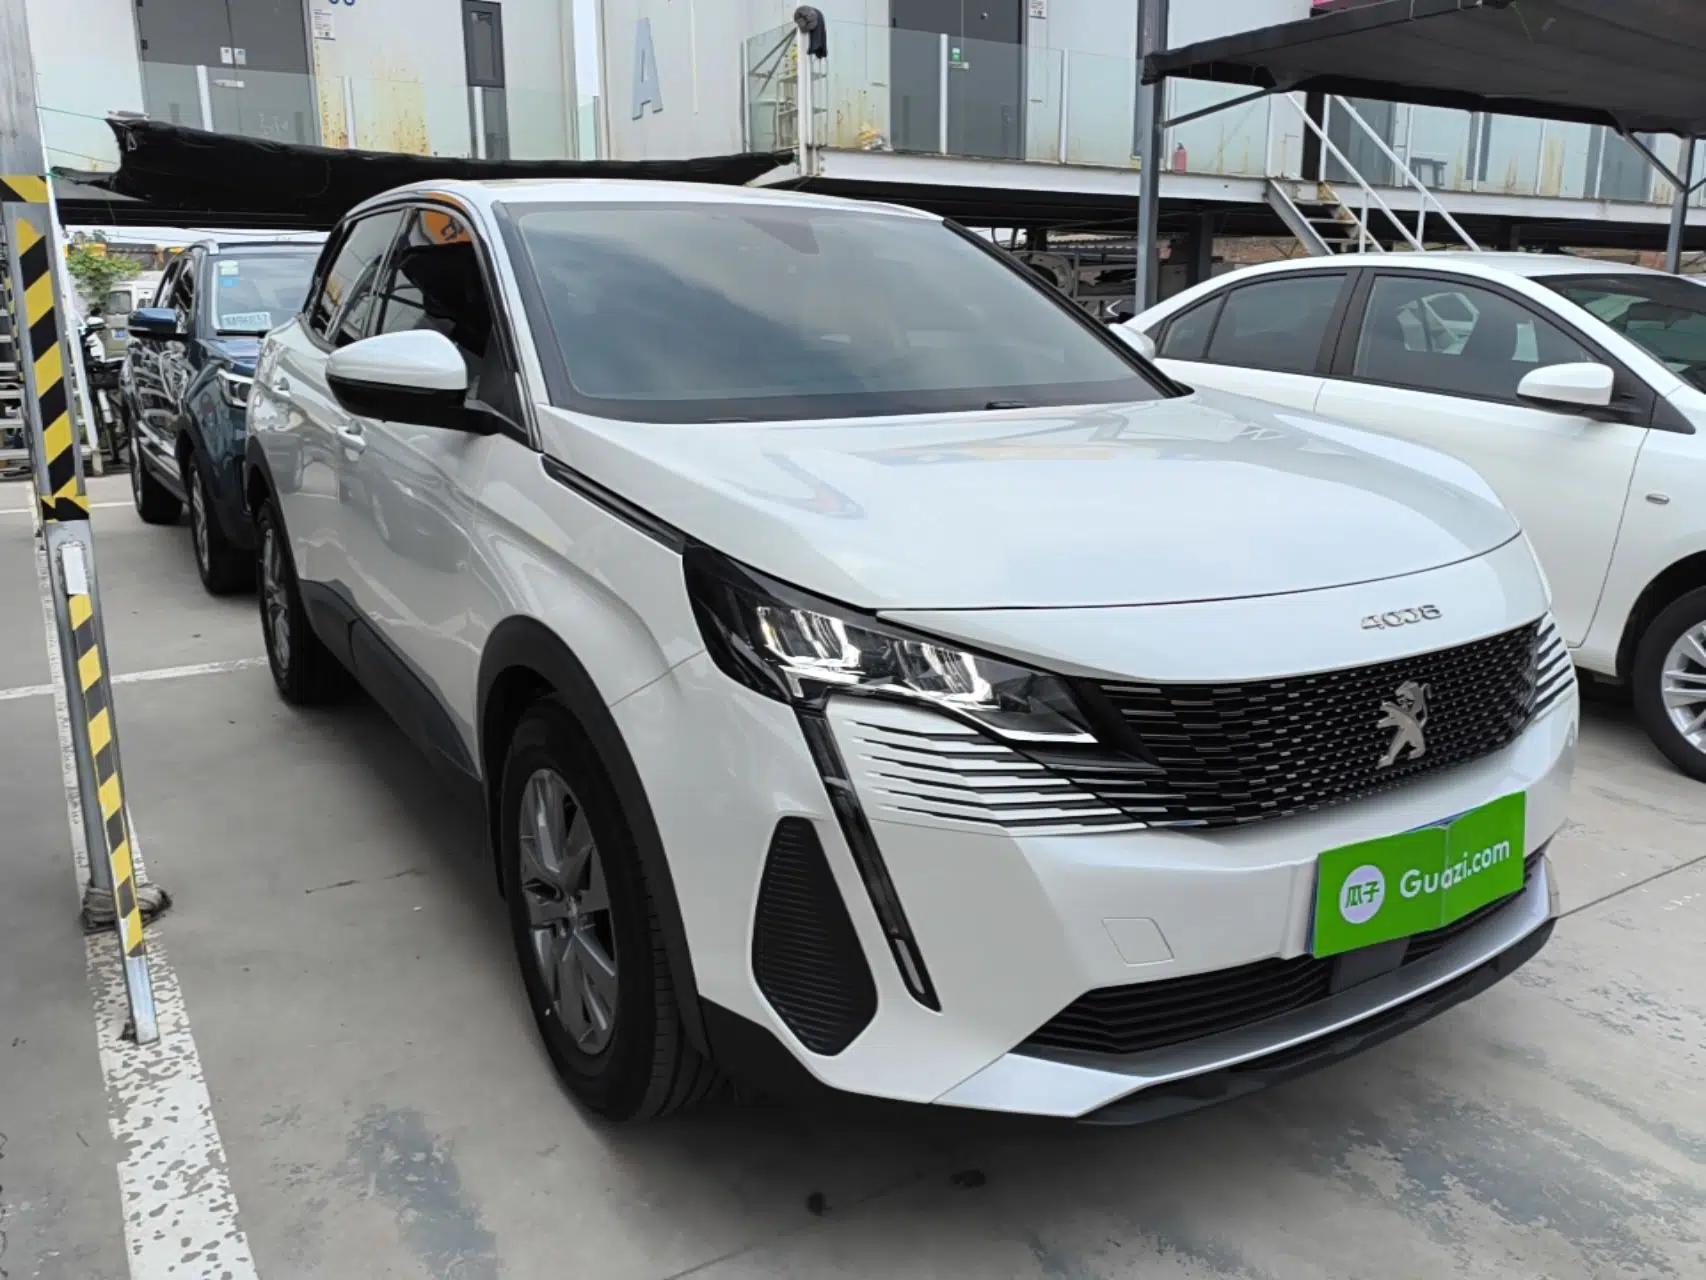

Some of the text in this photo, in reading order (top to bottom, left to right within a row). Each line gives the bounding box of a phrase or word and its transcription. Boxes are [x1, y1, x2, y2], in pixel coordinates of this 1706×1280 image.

[632, 17, 663, 121] A
[1345, 880, 1380, 908] 瓜子
[1400, 839, 1510, 898] Guazi.com
